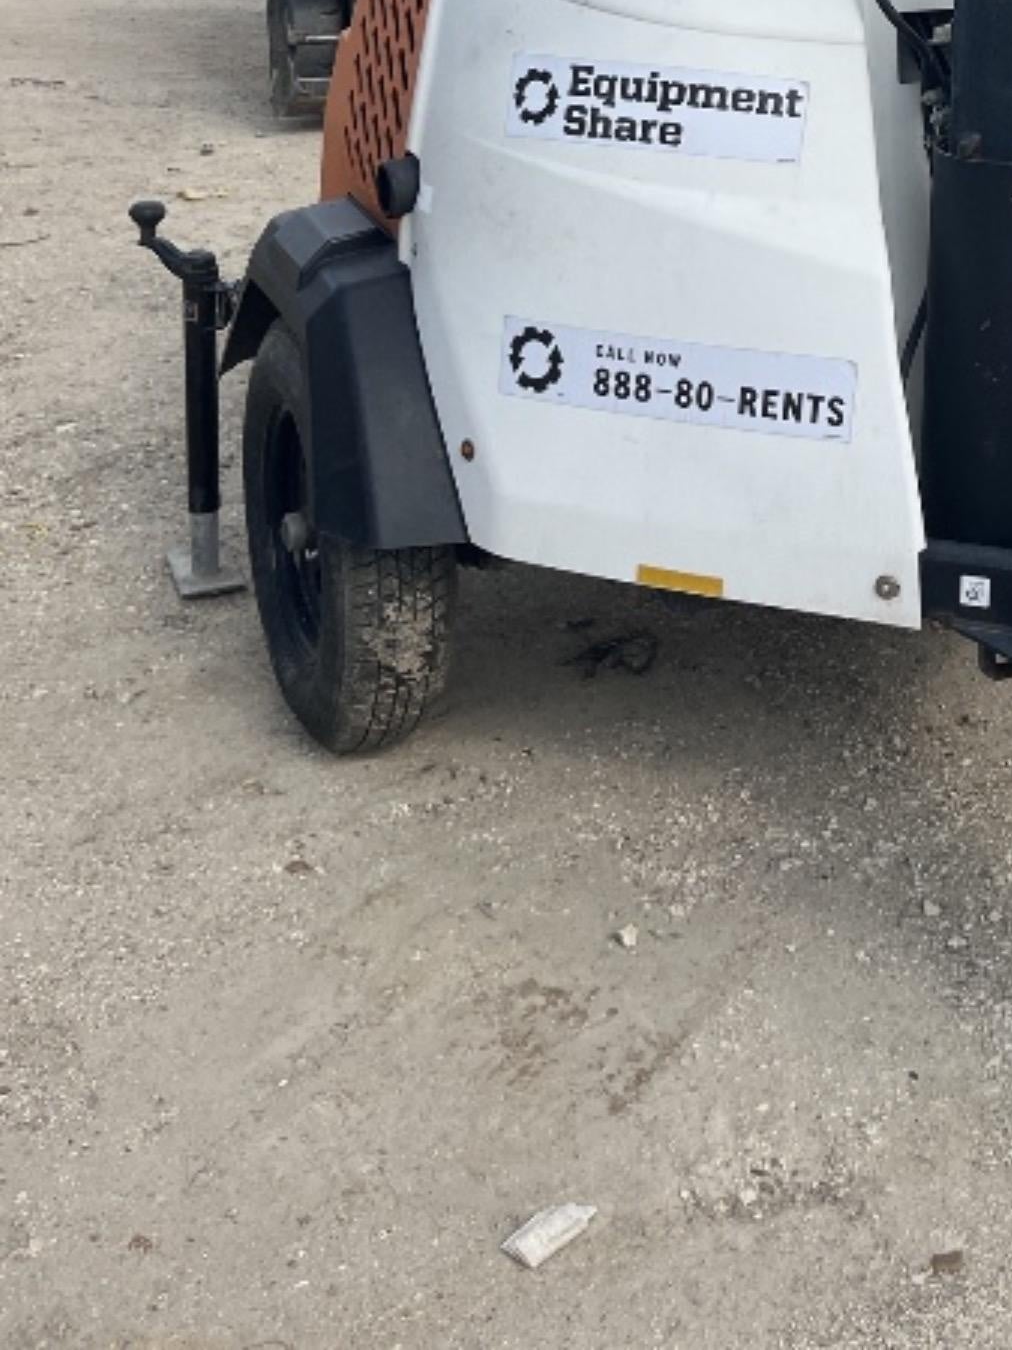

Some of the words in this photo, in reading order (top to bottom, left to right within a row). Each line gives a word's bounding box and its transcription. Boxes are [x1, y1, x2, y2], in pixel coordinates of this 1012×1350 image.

[568, 64, 804, 120] Equipment
[562, 104, 683, 148] Share
[595, 343, 637, 364] CALL
[643, 349, 682, 369] NOW
[593, 368, 846, 428] 888-80-RENTS
